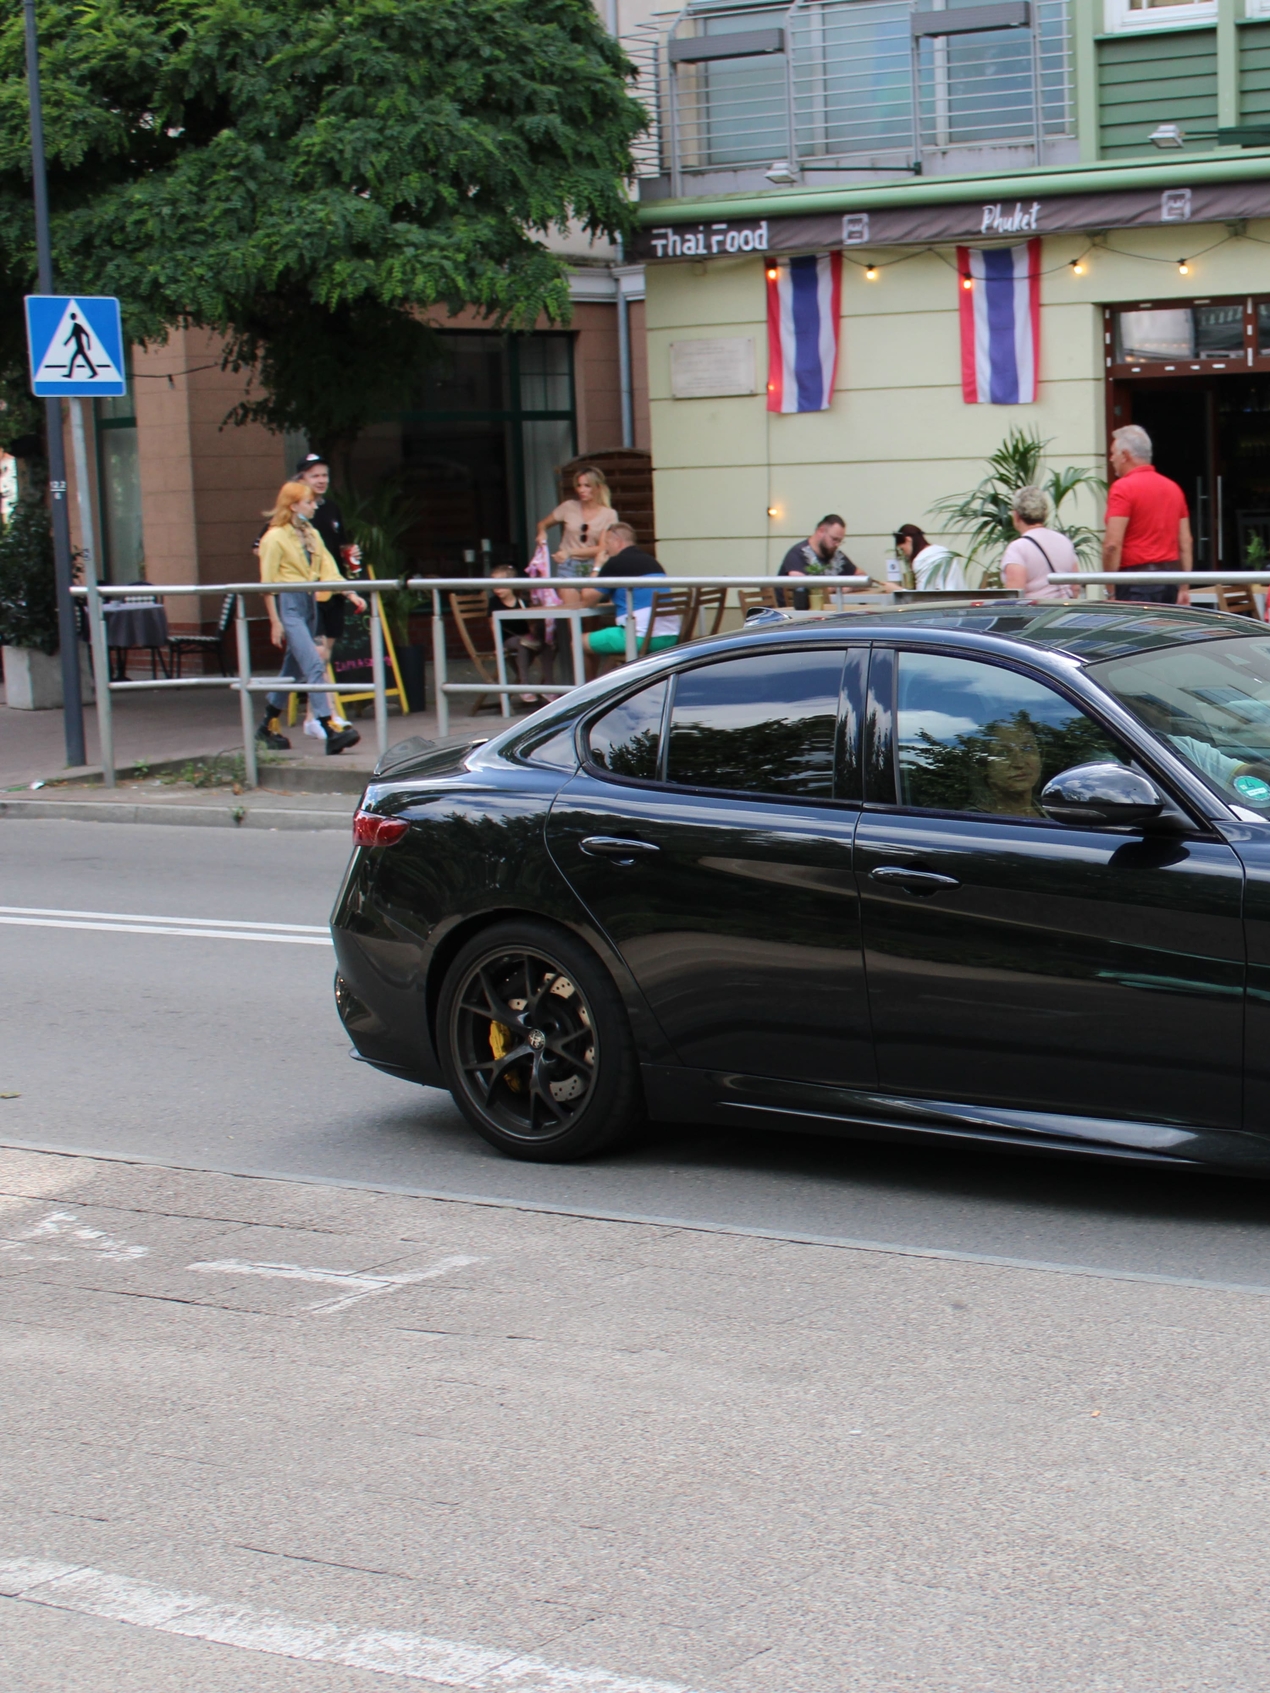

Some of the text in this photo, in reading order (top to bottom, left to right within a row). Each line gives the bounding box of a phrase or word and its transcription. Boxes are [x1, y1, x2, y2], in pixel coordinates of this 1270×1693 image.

[980, 201, 1042, 234] Phuket
[651, 220, 769, 258] Thai Food
